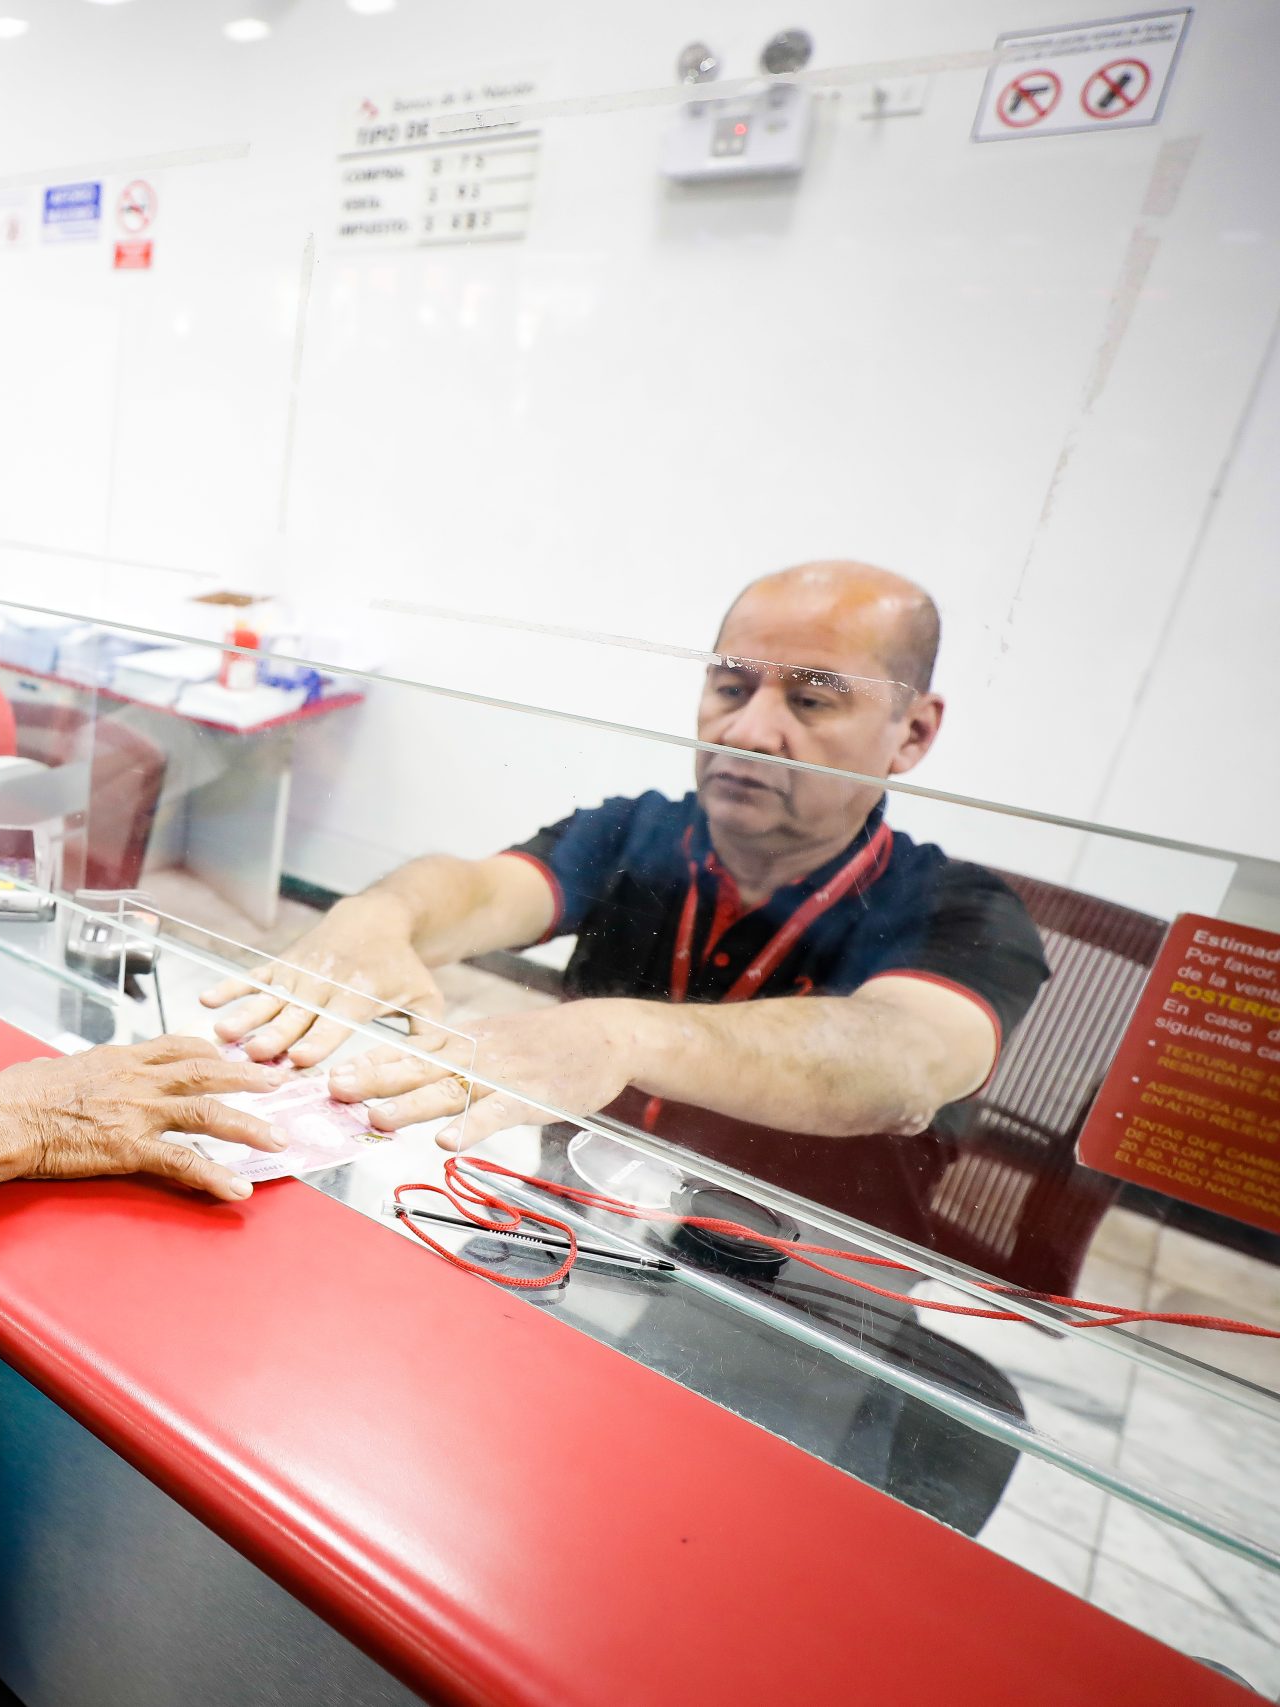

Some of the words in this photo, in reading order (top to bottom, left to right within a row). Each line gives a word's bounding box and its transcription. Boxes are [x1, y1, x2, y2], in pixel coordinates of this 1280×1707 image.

[1185, 946, 1222, 966] Por
[1177, 966, 1203, 982] de
[1208, 972, 1228, 988] la
[1162, 997, 1190, 1016] En
[1204, 1012, 1253, 1033] caso
[1154, 1017, 1253, 1053] siguientes
[1165, 1042, 1238, 1074] TEXTURA
[1125, 1126, 1147, 1143] DE
[1132, 1115, 1184, 1141] TINTAS
[1136, 1157, 1202, 1188] ESCUDO
